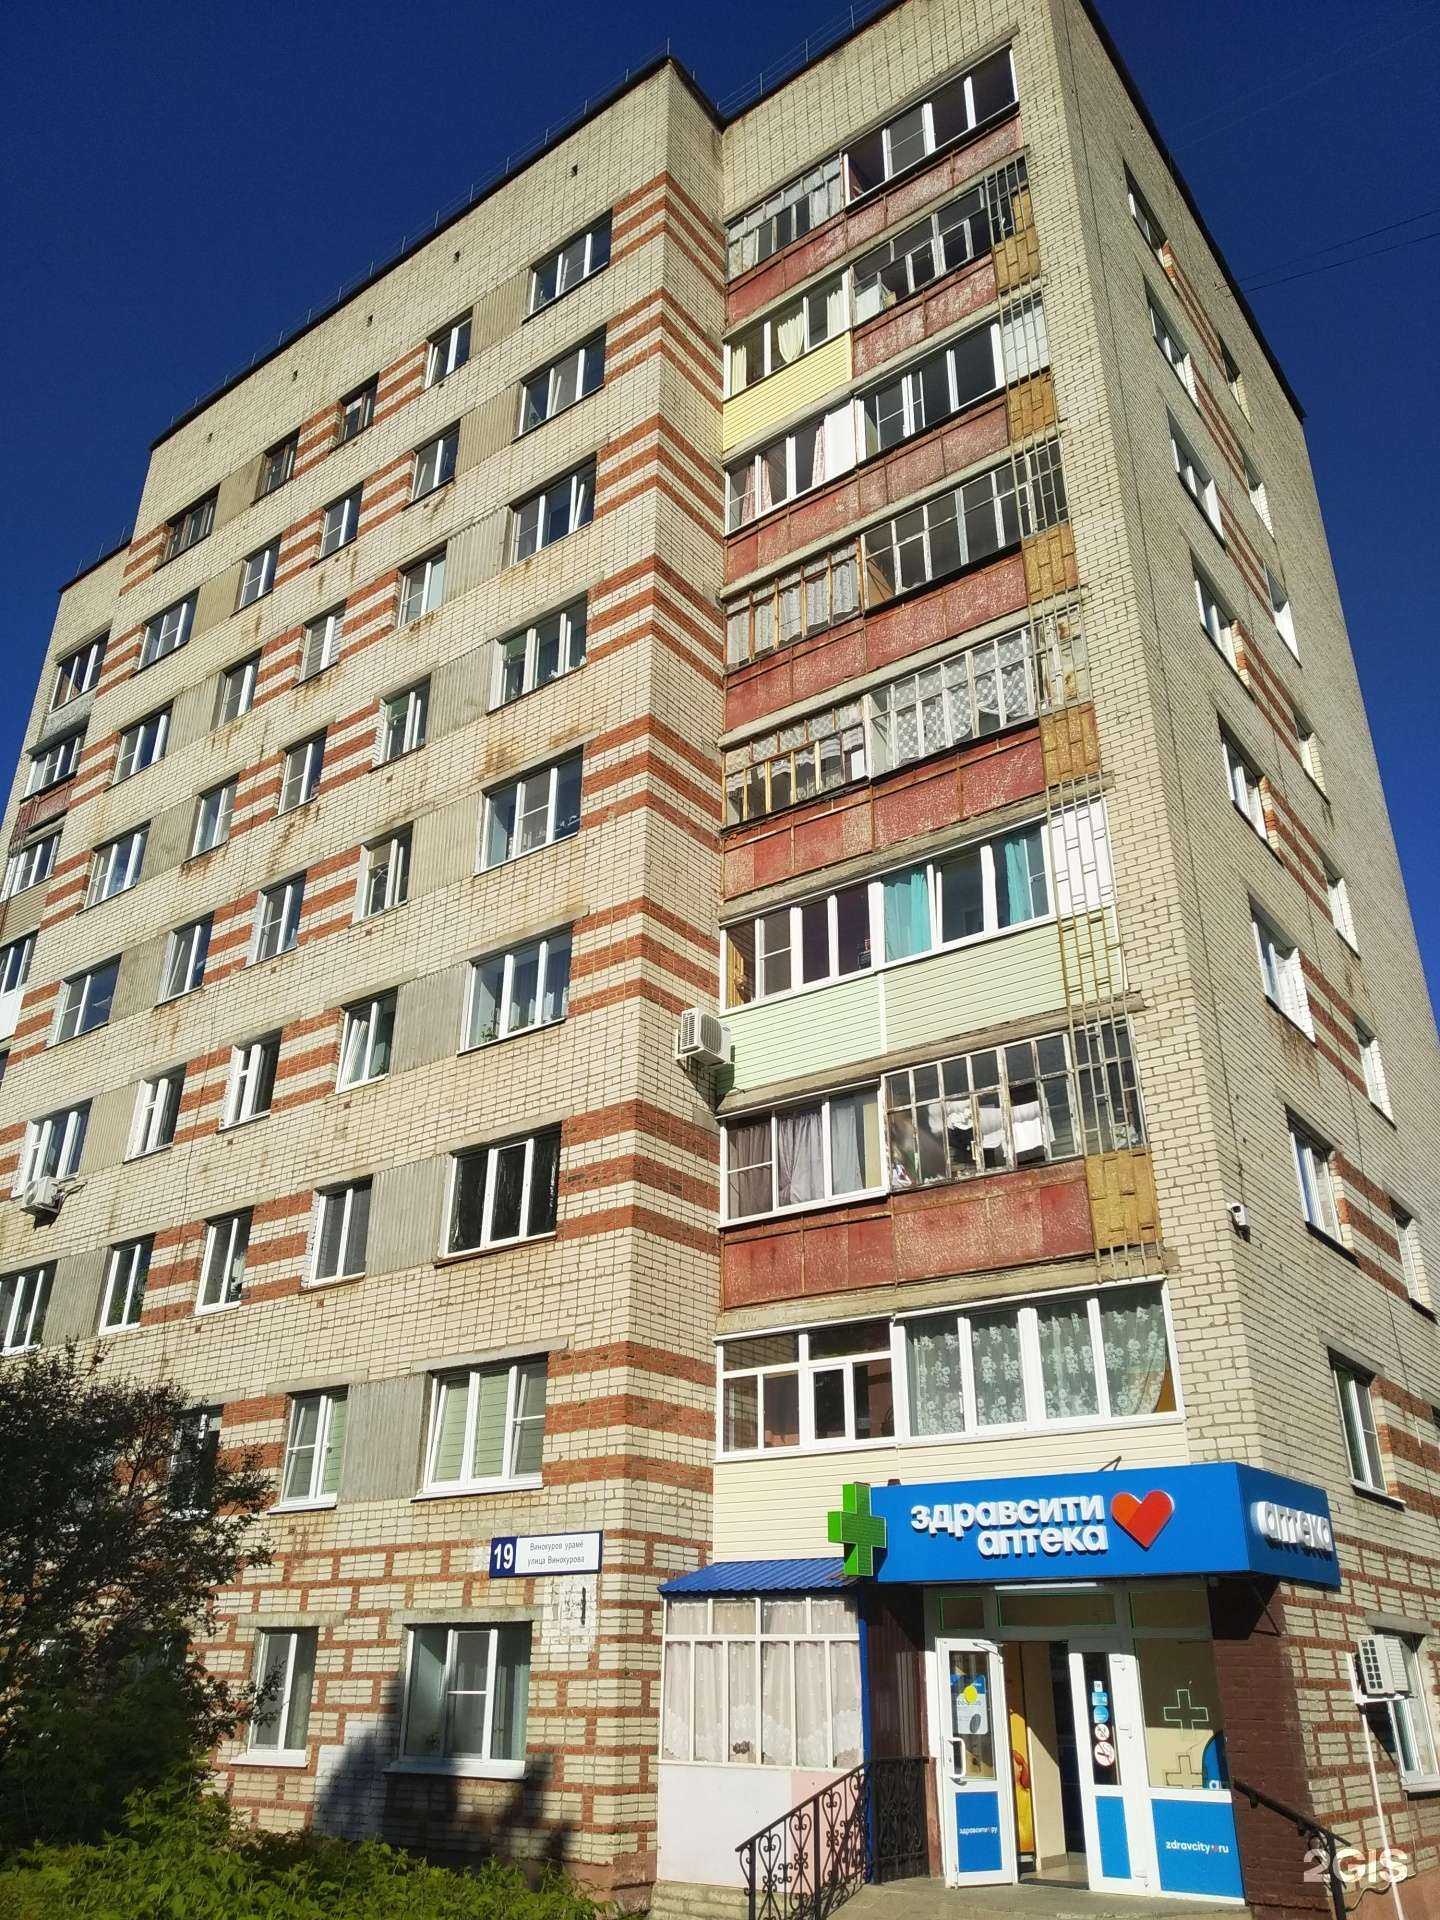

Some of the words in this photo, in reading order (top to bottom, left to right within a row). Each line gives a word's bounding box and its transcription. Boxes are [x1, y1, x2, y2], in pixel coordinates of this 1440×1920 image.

[910, 1495, 1106, 1538] здравсити
[1250, 1501, 1334, 1552] аптека
[494, 1543, 514, 1570] 19
[977, 1525, 1109, 1557] аптека
[528, 1557, 546, 1568] улица
[547, 1555, 585, 1565] Винокурова
